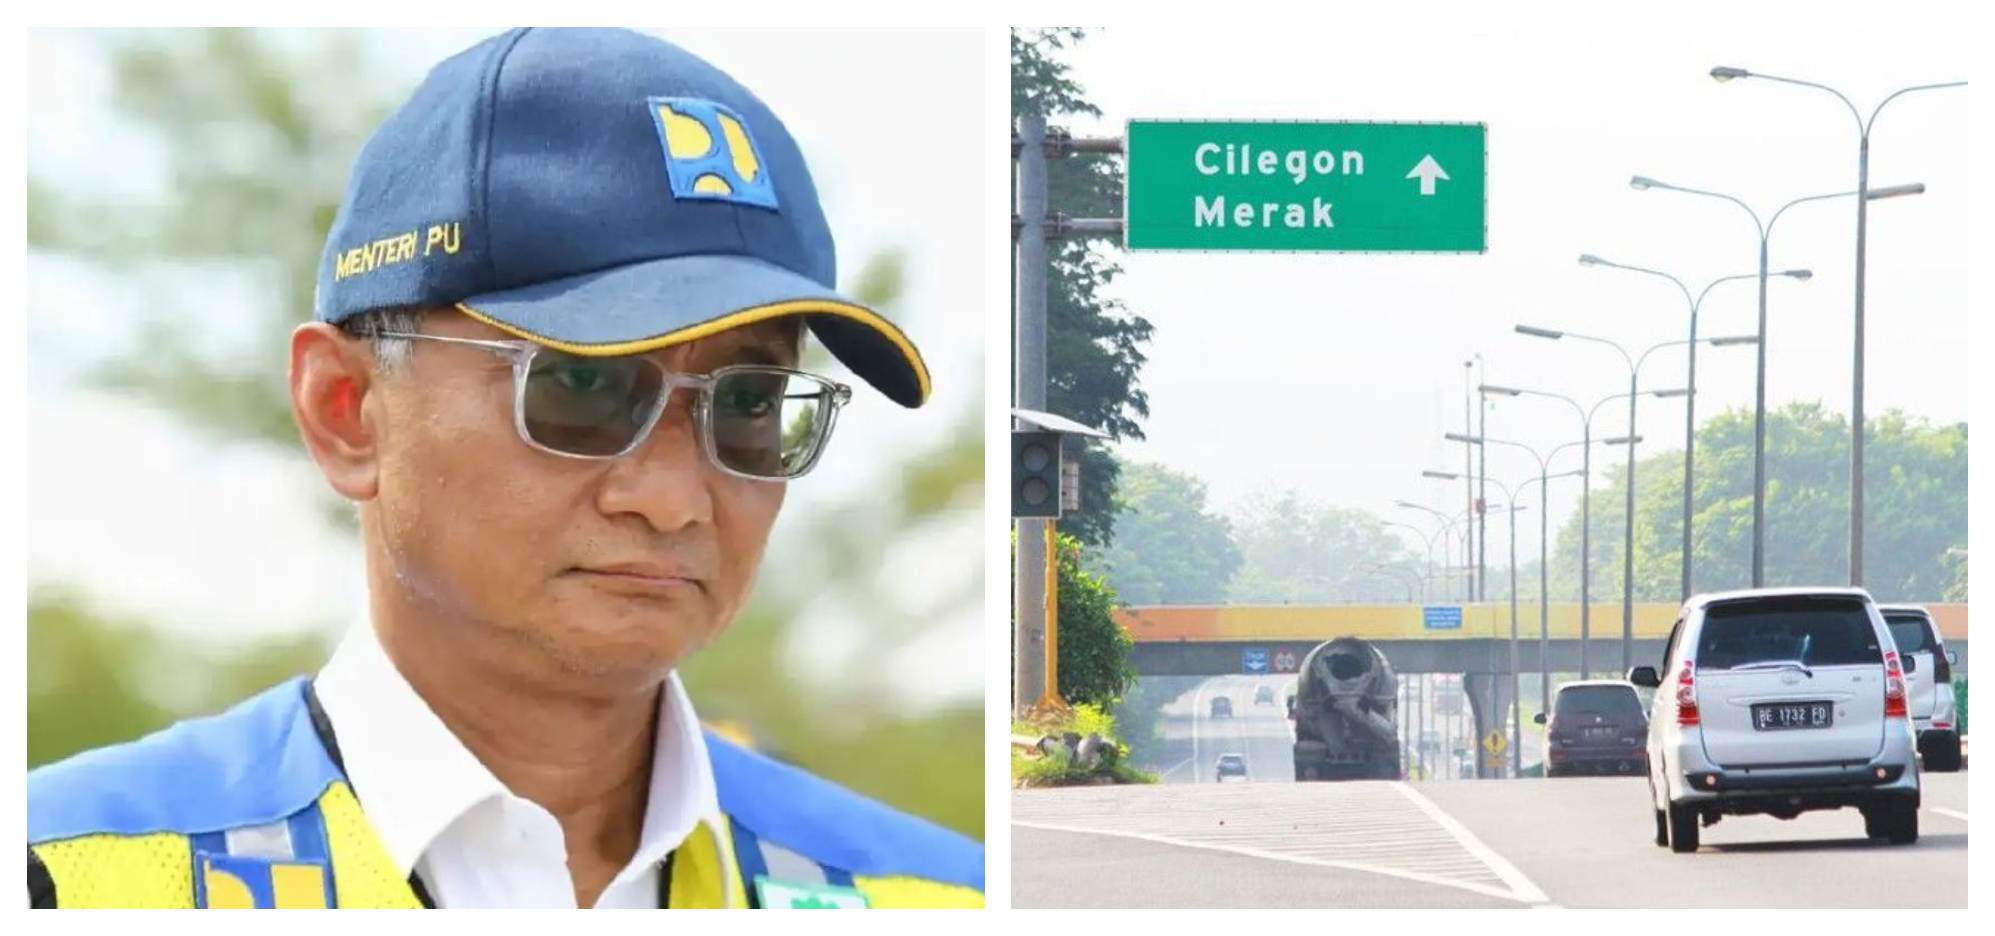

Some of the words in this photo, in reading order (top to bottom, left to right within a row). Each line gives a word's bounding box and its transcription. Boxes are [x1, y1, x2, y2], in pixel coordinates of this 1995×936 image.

[1195, 142, 1364, 185] Cilegon
[1195, 196, 1335, 228] Merak
[335, 229, 418, 281] MENTERI
[423, 222, 460, 256] PU
[1759, 708, 1773, 722] BE
[1779, 708, 1806, 722] 1732
